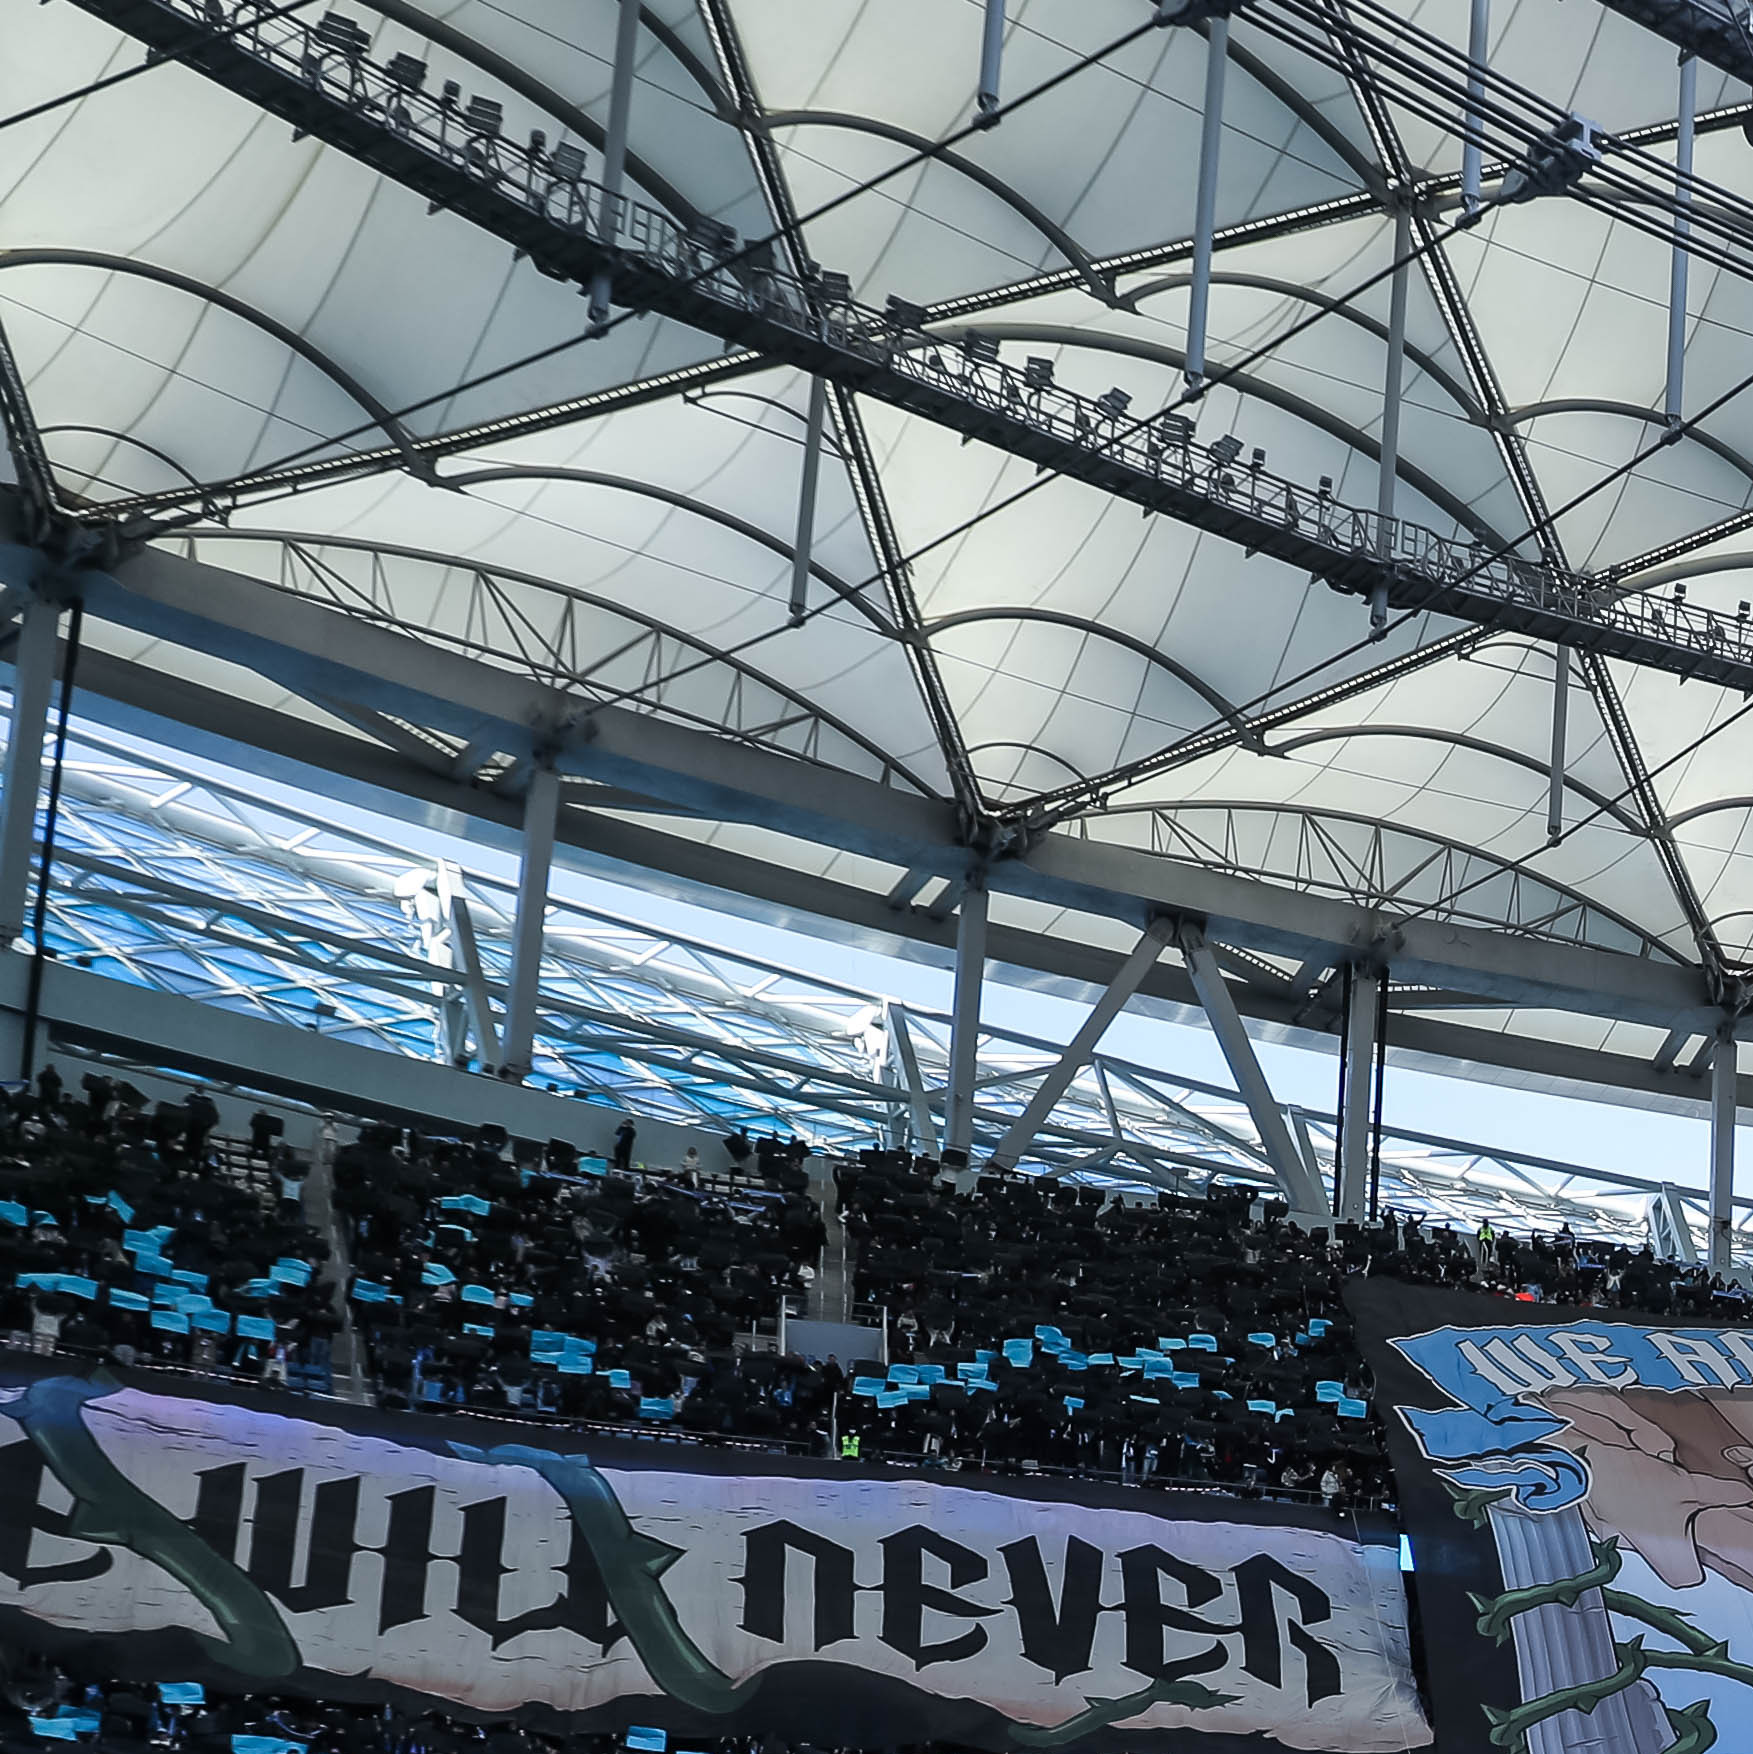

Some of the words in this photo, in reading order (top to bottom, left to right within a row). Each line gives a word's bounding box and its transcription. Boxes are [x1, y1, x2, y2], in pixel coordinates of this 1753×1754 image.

[1460, 1333, 1636, 1397] WE
[194, 1463, 630, 1658] WILL
[736, 1521, 1347, 1710] NEVER
